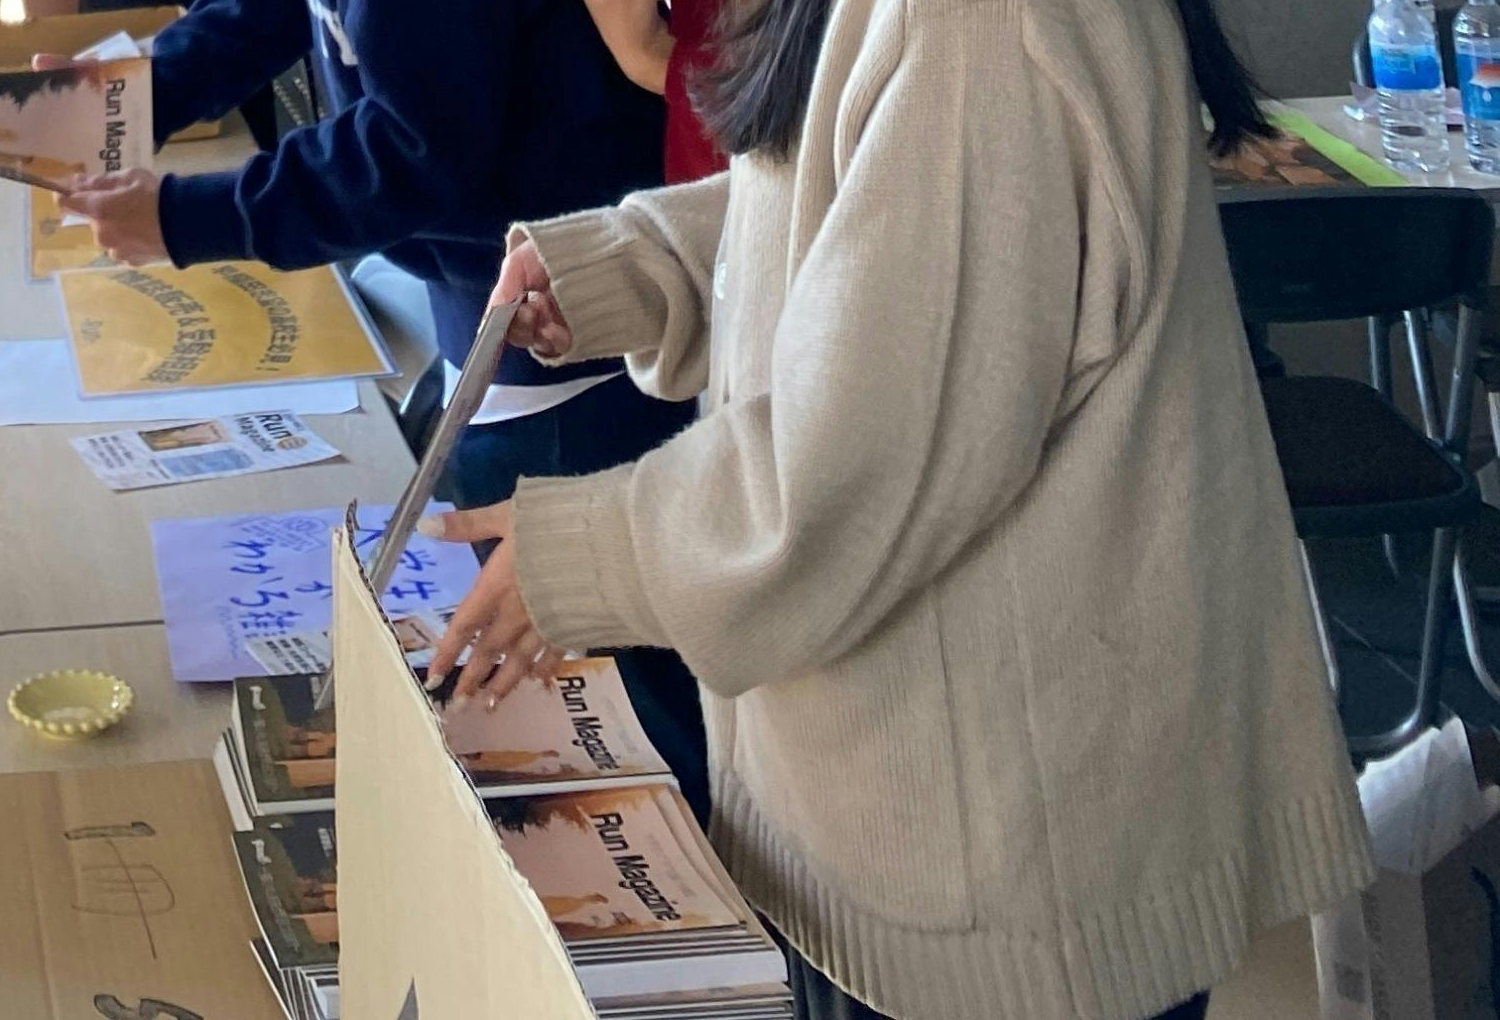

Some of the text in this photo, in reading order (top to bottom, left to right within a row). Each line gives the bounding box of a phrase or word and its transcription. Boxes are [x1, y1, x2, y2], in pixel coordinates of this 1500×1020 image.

[99, 77, 126, 173] Run Maga
[257, 412, 293, 441] Run
[556, 674, 587, 714] Run
[570, 715, 621, 772] Magazine
[591, 811, 630, 858] Run
[612, 854, 682, 922] Magazine
